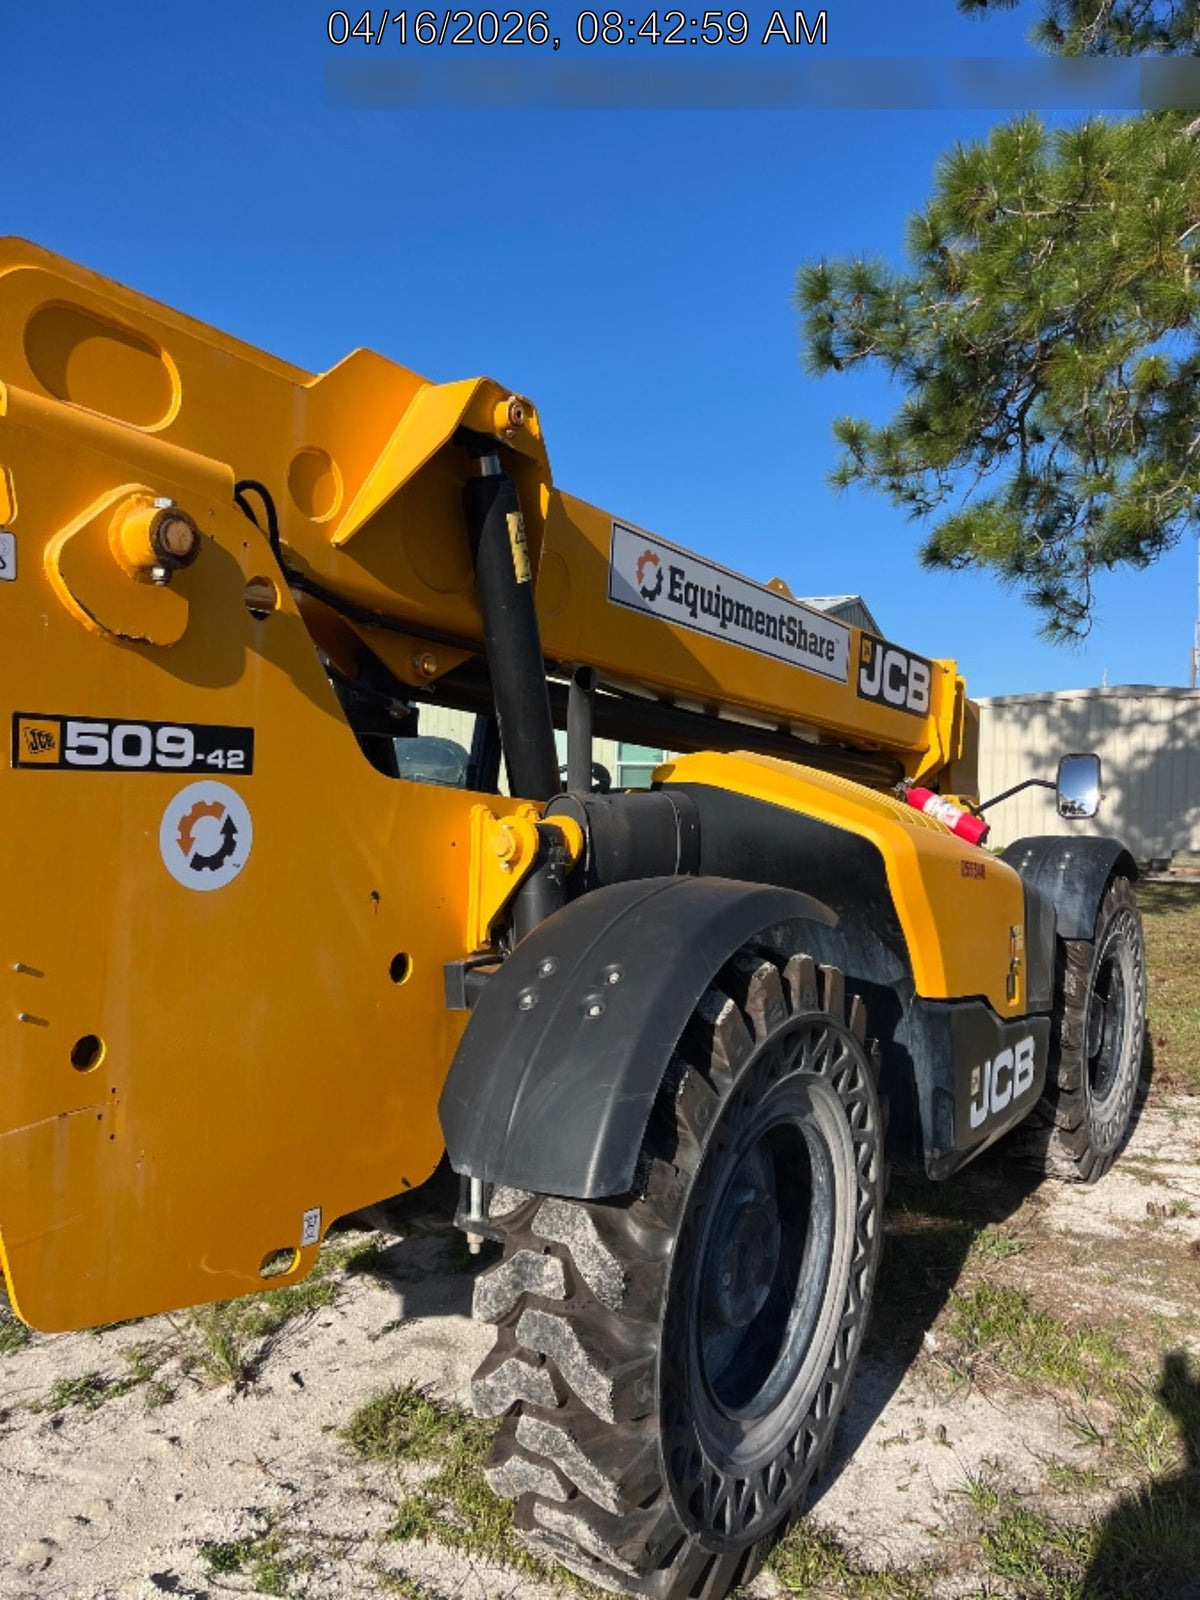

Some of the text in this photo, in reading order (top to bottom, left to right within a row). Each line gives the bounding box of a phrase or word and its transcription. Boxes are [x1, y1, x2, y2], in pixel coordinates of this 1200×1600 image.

[668, 565, 835, 661] EquipmentShare
[860, 644, 930, 713] JCB
[970, 1035, 1035, 1128] JCB
